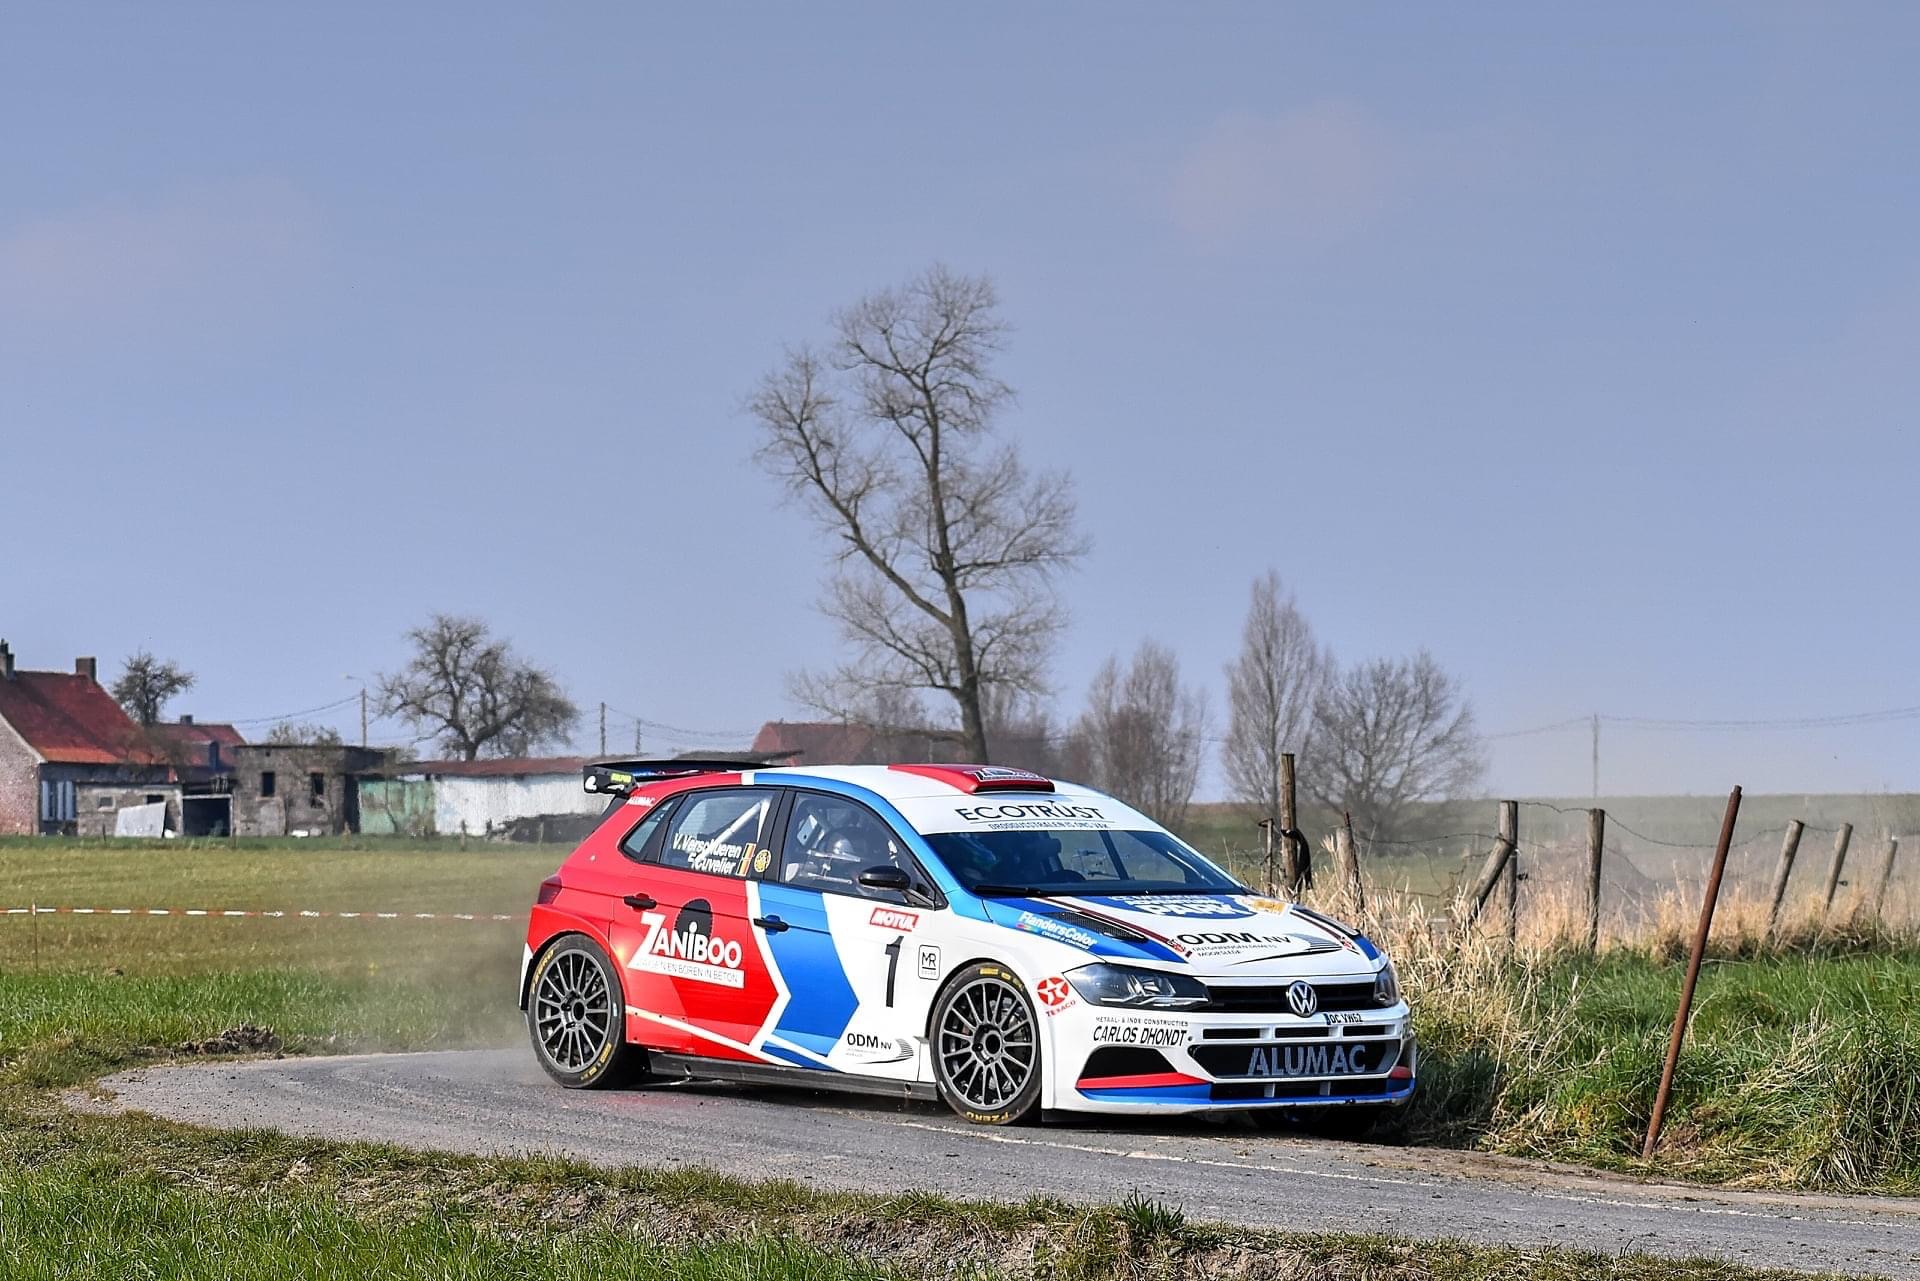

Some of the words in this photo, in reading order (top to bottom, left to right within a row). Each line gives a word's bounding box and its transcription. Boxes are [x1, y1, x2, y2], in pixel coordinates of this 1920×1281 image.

[955, 804, 1105, 820] ECOTRUST
[1020, 911, 1097, 946] FlandersColor
[1176, 932, 1262, 945] ODM
[1261, 935, 1291, 943] NV
[921, 952, 937, 967] MR
[713, 970, 738, 983] BETON
[884, 935, 904, 1008] 1
[1045, 1000, 1076, 1017] TEXACO
[1143, 1018, 1189, 1027] CONSTRUCTIES
[847, 1033, 878, 1048] ODM
[880, 1041, 892, 1050] NV
[1093, 1026, 1138, 1043] CARLOS
[1139, 1028, 1187, 1046] DHONDT
[1247, 1045, 1366, 1076] ALUMAC
